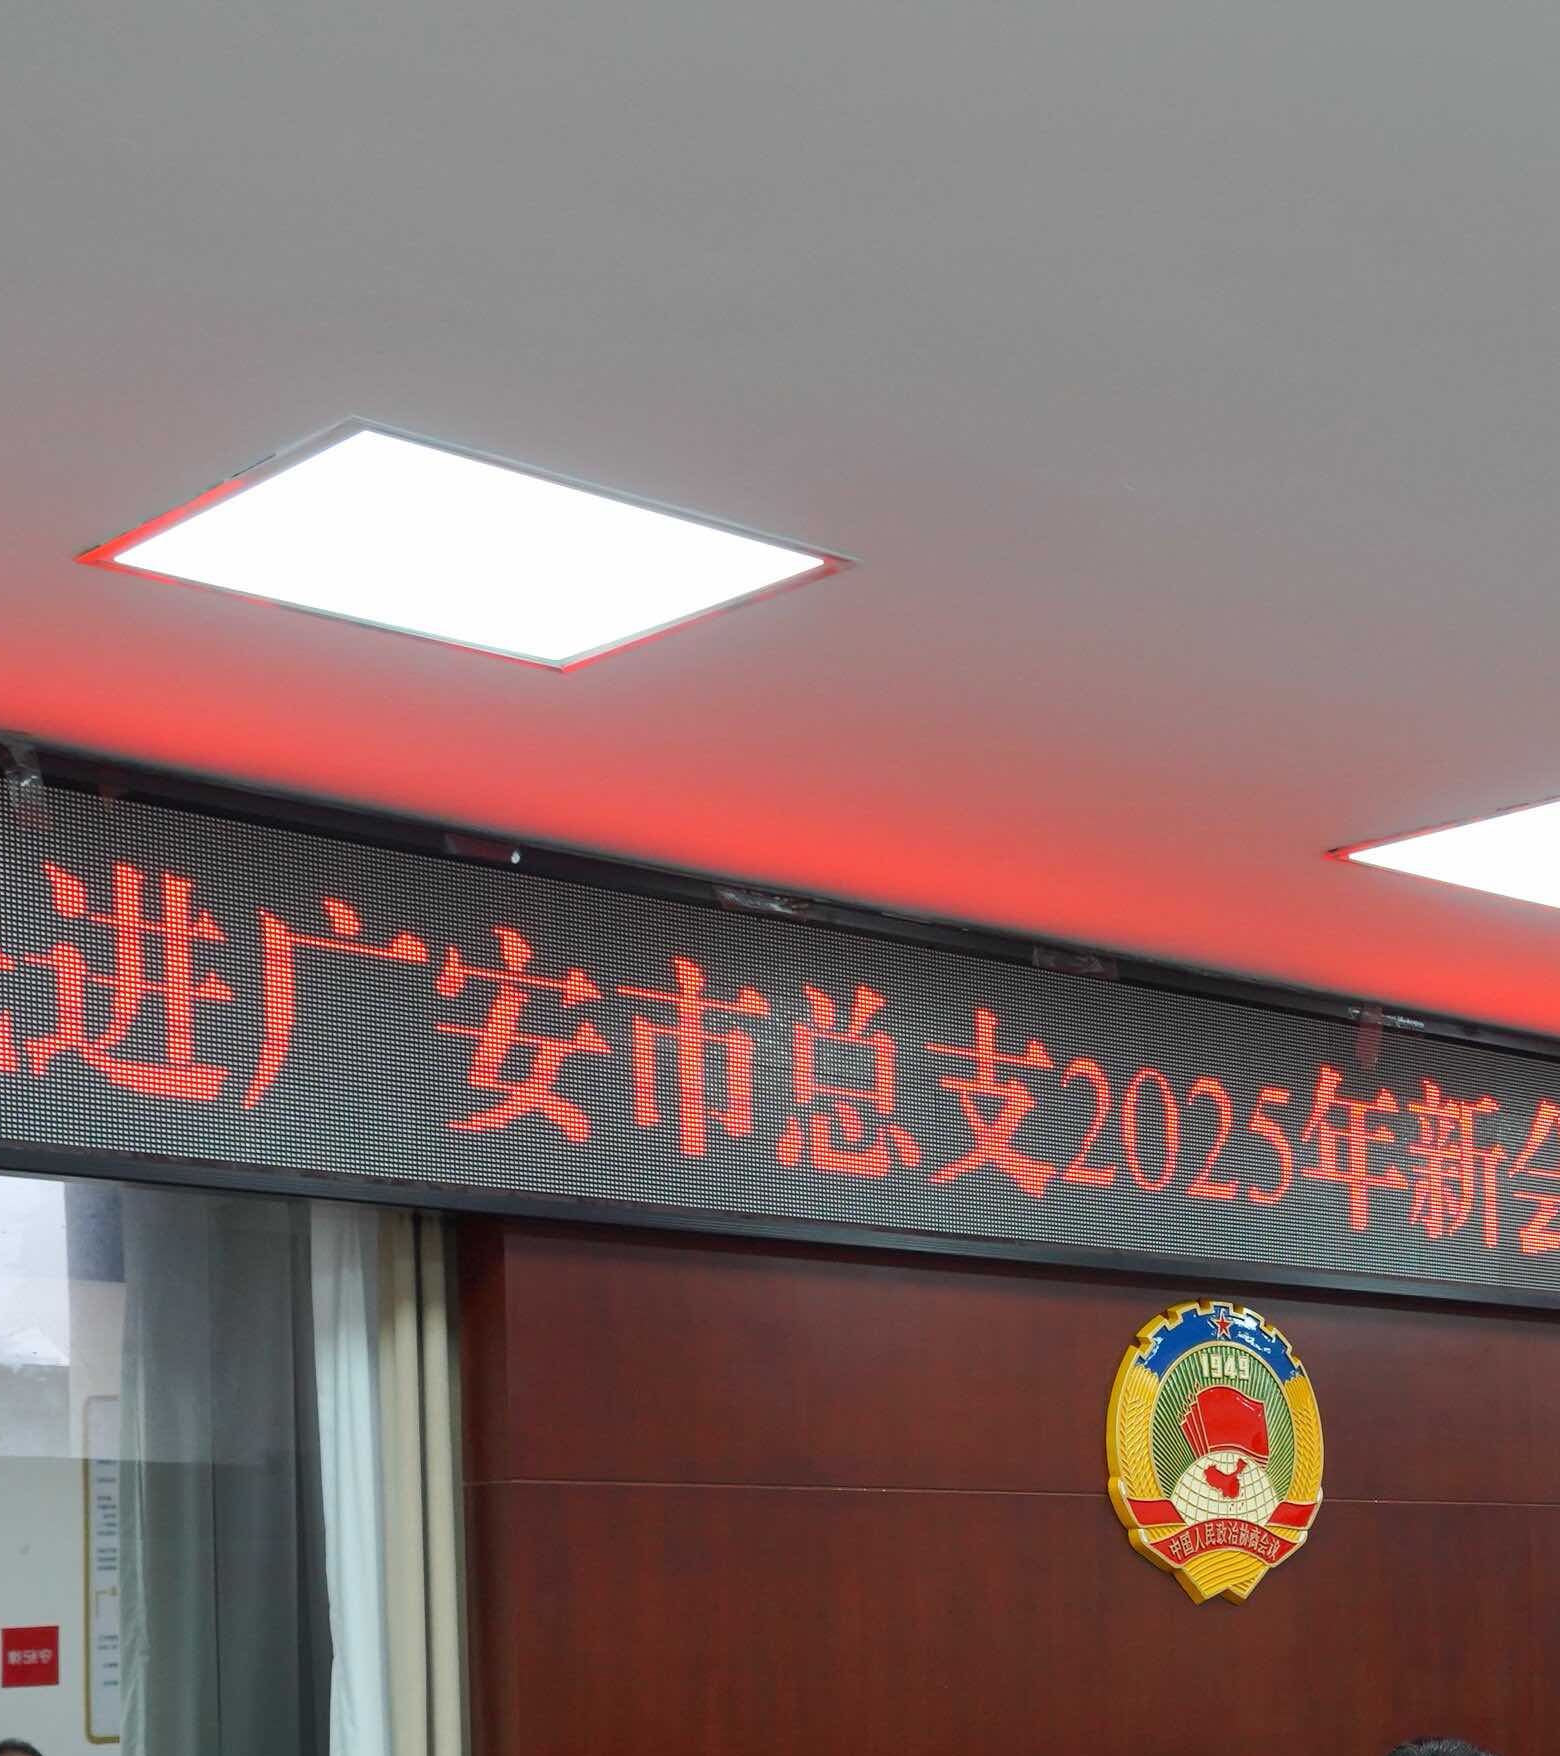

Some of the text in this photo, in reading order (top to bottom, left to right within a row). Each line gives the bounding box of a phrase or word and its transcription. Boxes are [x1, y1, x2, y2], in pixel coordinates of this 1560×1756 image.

[1200, 1352, 1250, 1381] 1949
[1168, 1520, 1281, 1562] 中国人民政治协商会议
